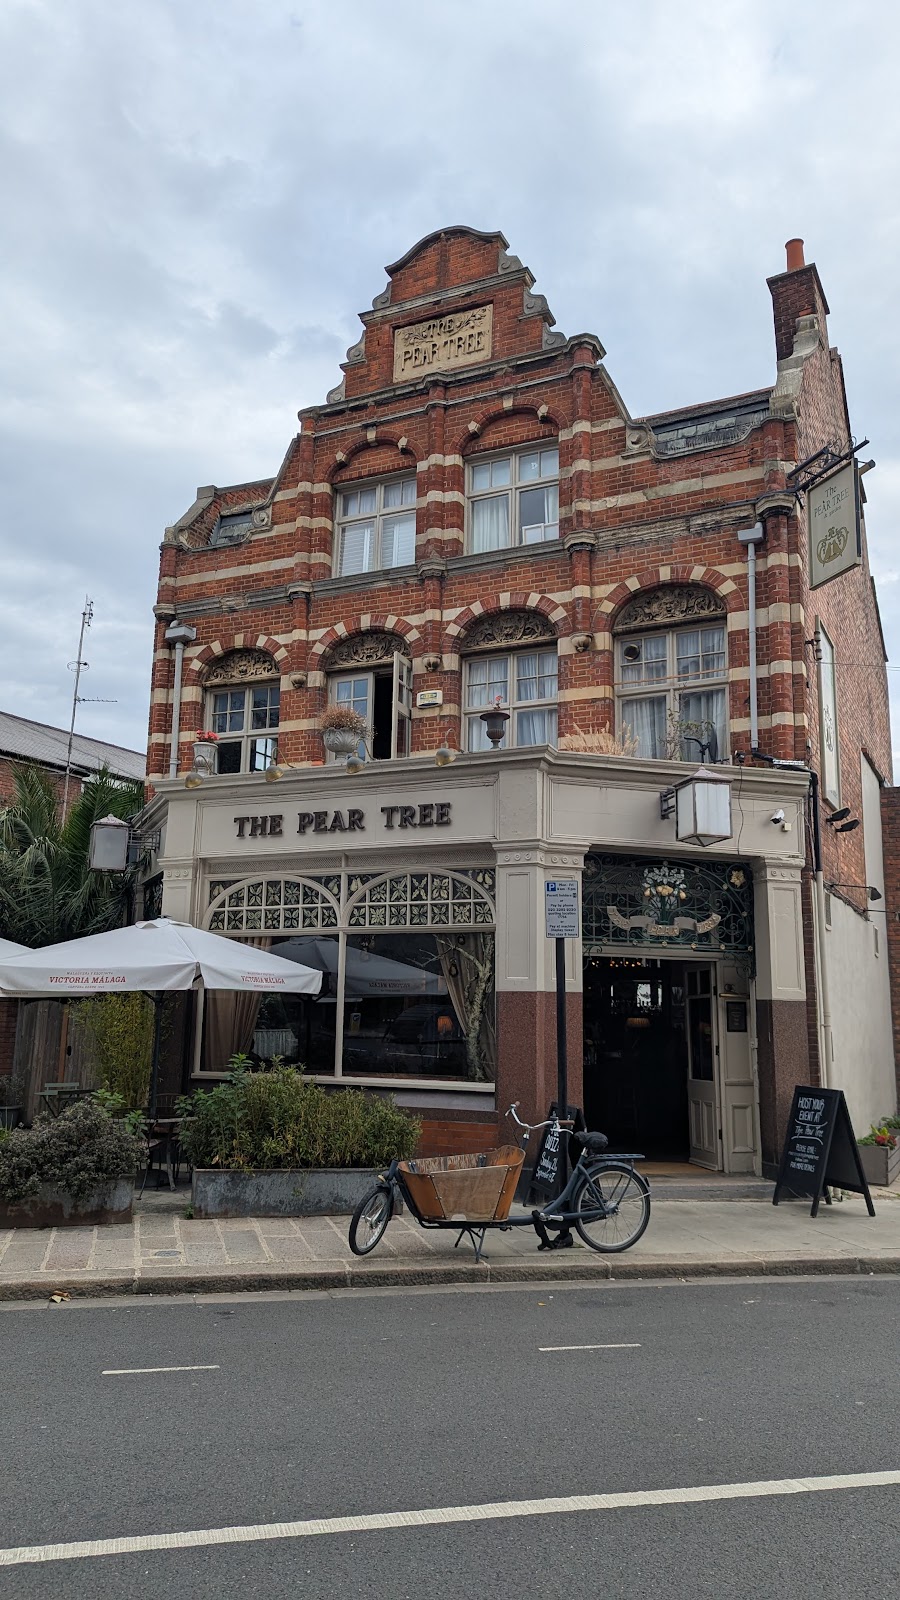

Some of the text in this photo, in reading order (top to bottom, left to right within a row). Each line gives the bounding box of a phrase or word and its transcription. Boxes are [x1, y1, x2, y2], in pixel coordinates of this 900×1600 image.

[401, 330, 485, 371] PEAR TREE
[824, 486, 836, 497] The
[814, 487, 850, 517] PEAR TREE
[233, 802, 452, 838] THE PEAR TREE
[91, 974, 126, 983] MÁLAGA
[240, 975, 264, 984] VICTORIA
[798, 1096, 825, 1113] HOST YOUR
[799, 1110, 821, 1122] EVENT AT
[795, 1125, 803, 1137] The
[815, 1125, 824, 1138] Tree
